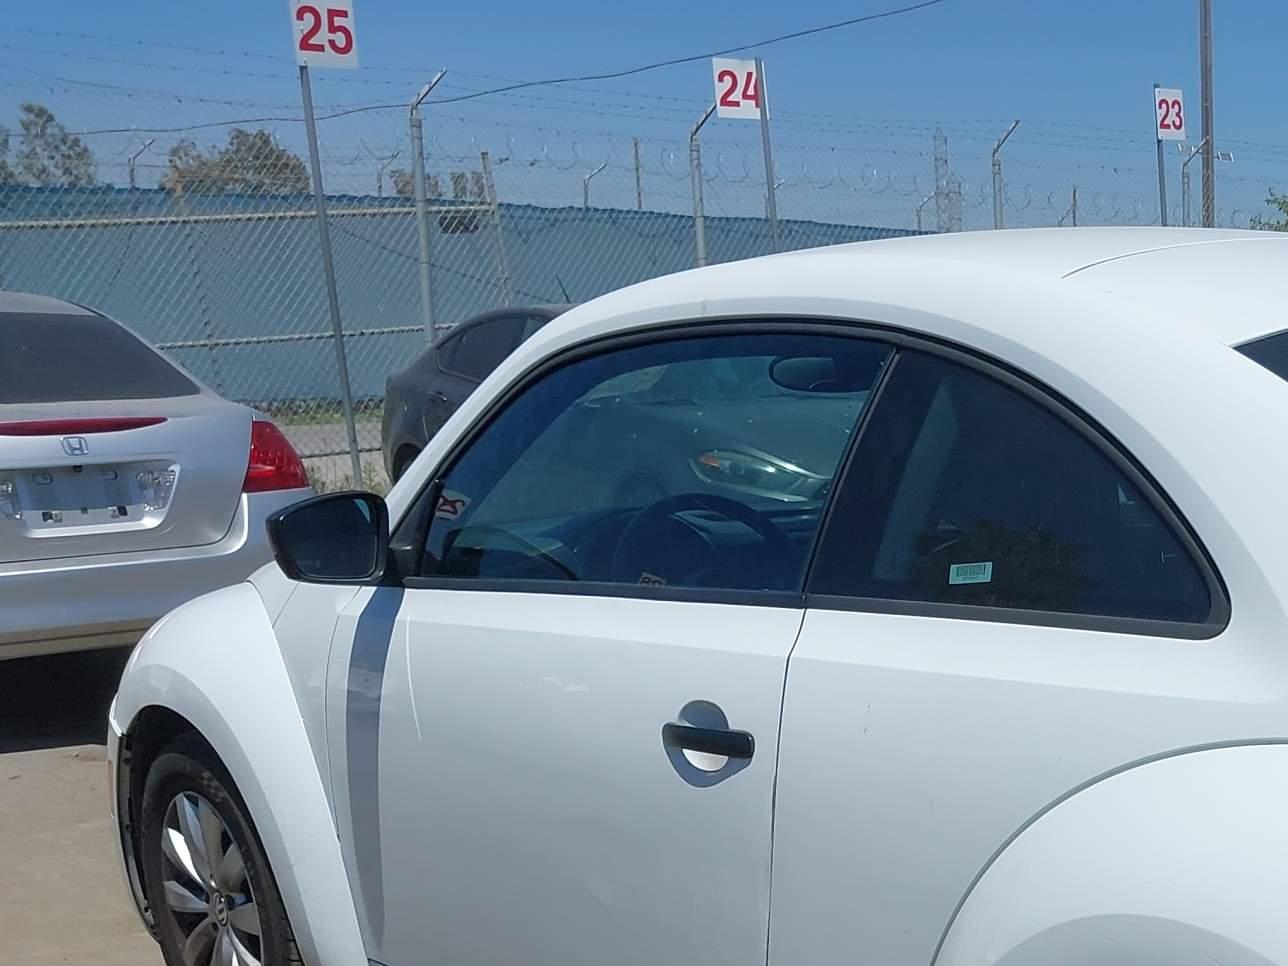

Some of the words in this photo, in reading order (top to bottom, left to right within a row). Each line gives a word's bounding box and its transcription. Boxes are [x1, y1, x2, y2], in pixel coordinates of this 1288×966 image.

[296, 5, 353, 55] 25
[716, 69, 761, 110] 24
[1157, 98, 1183, 131] 23
